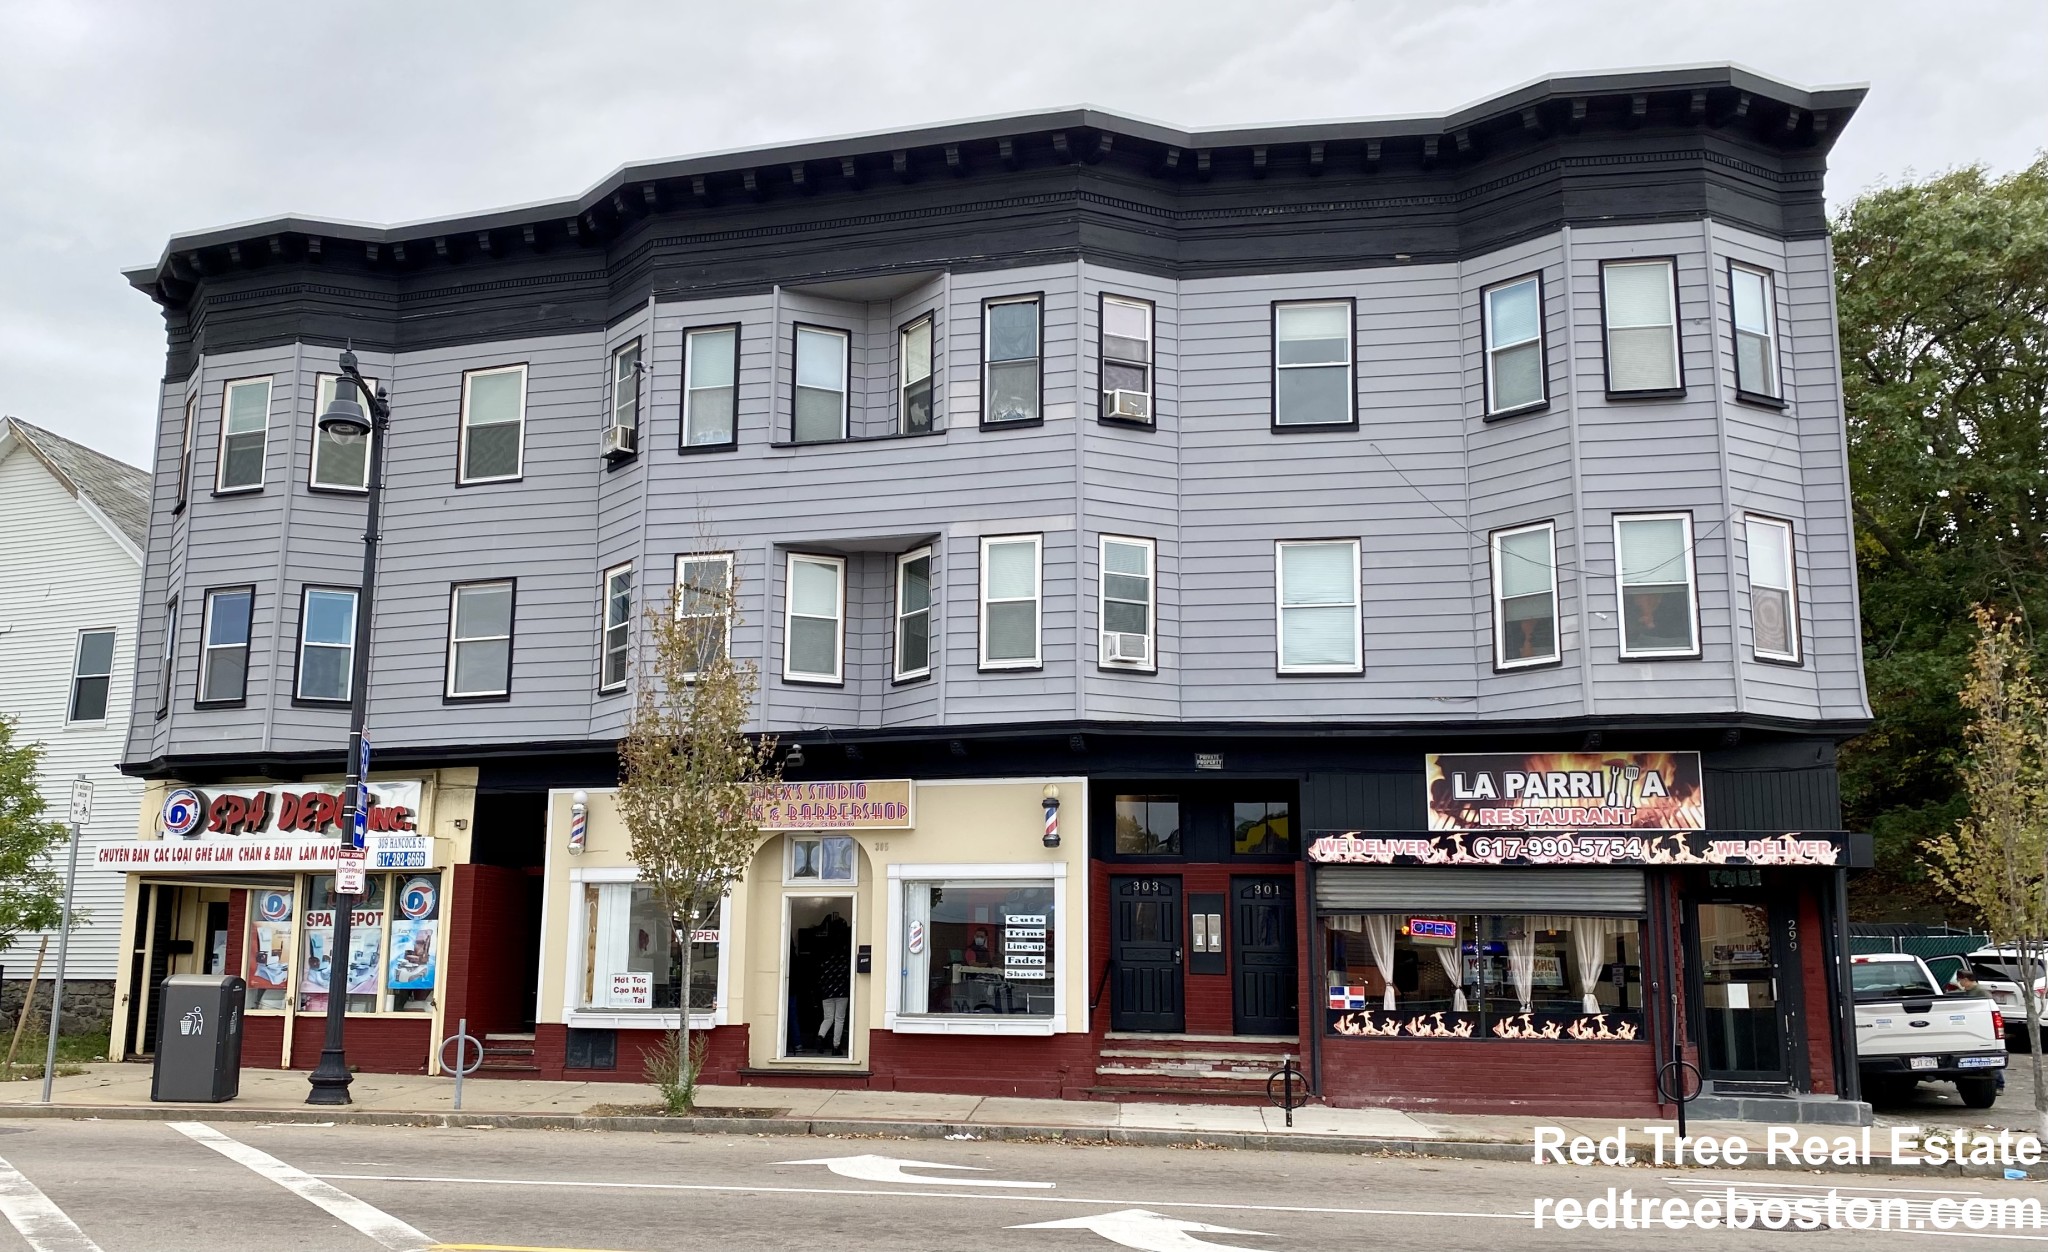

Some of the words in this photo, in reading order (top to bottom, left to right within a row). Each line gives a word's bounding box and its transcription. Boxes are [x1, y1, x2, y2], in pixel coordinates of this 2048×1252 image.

[809, 782, 867, 800] STUDIO
[1453, 771, 1498, 798] LA
[208, 791, 267, 833] SPA
[367, 806, 412, 831] INC.
[786, 802, 908, 820] BARBERSHOP
[1480, 807, 1635, 827] RESTAURANT
[378, 837, 388, 848] 309
[390, 837, 417, 848] HANCOCK
[1320, 839, 1347, 853] WE
[1353, 840, 1430, 855] DELIVER
[1475, 838, 1641, 858] 617-990-5754
[1715, 841, 1746, 856] WE
[1750, 841, 1831, 857] DELIVER
[265, 846, 271, 860] &
[378, 853, 425, 866] 617-282-6666
[1134, 882, 1159, 891] 303
[1255, 885, 1280, 894] 301
[306, 911, 332, 926] SPA
[1413, 922, 1454, 935] OPEN
[1788, 919, 1797, 951] 299
